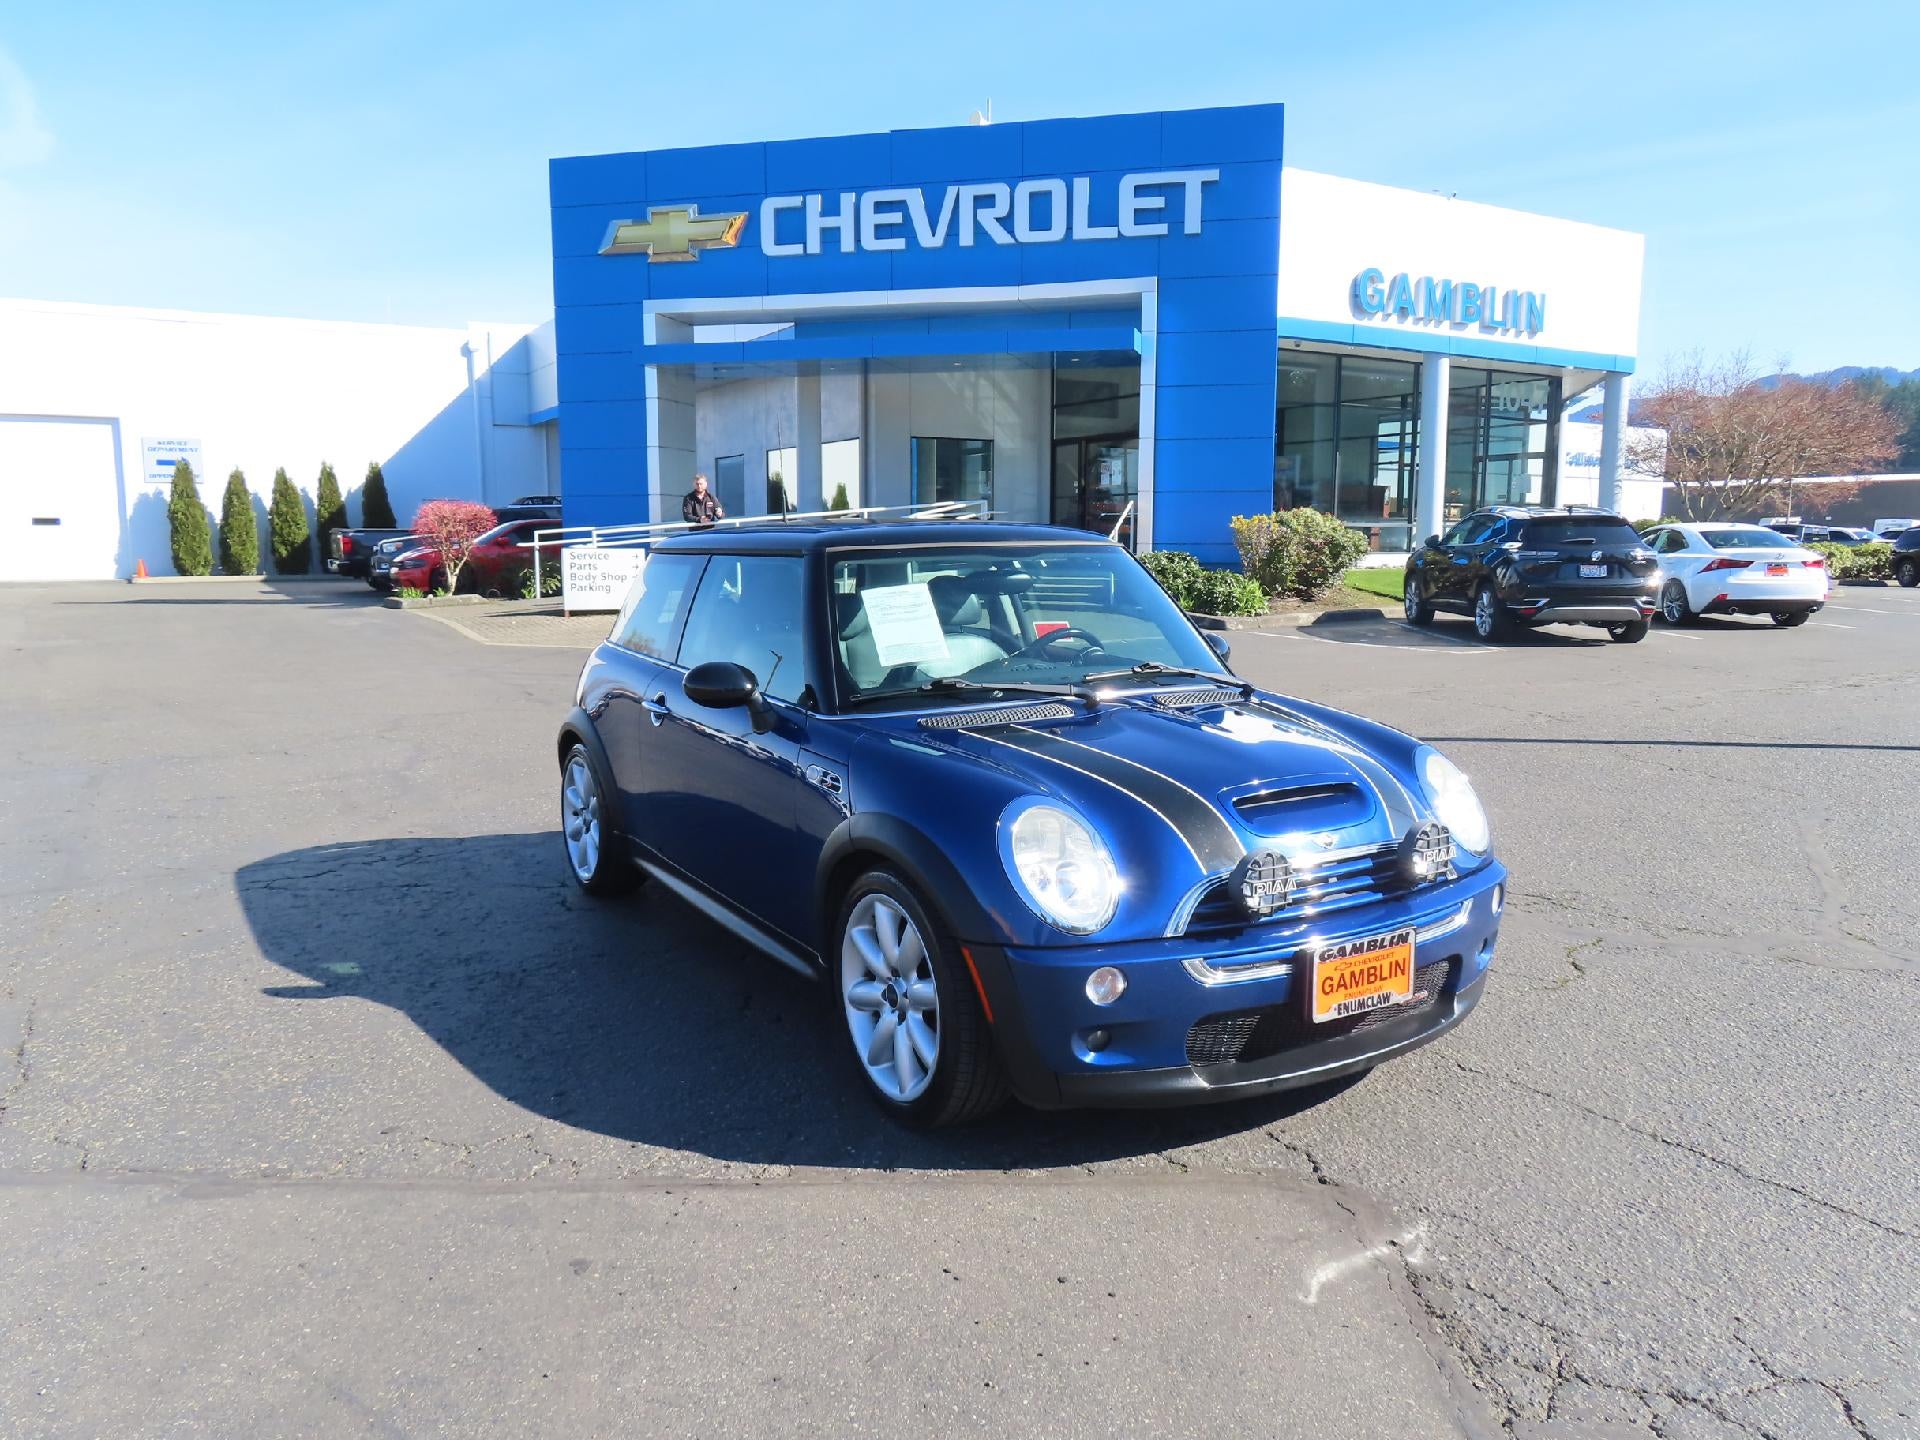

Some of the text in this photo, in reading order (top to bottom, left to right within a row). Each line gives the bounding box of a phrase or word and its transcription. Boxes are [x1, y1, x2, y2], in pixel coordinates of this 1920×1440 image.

[759, 168, 1220, 256] CHEVROLET
[1350, 268, 1546, 336] GAMBLIN
[569, 551, 610, 560] Service
[569, 562, 598, 571] Parts
[570, 572, 628, 583] Body Shop
[570, 583, 611, 594] Parking
[1424, 846, 1457, 862] PIAA
[1253, 879, 1297, 896] PIAA
[1319, 932, 1410, 961] GAMBLIN
[1353, 952, 1395, 967] CHEVROLET
[1321, 958, 1406, 996] GAMBLIN
[1337, 992, 1392, 1016] ENUMCLAW
